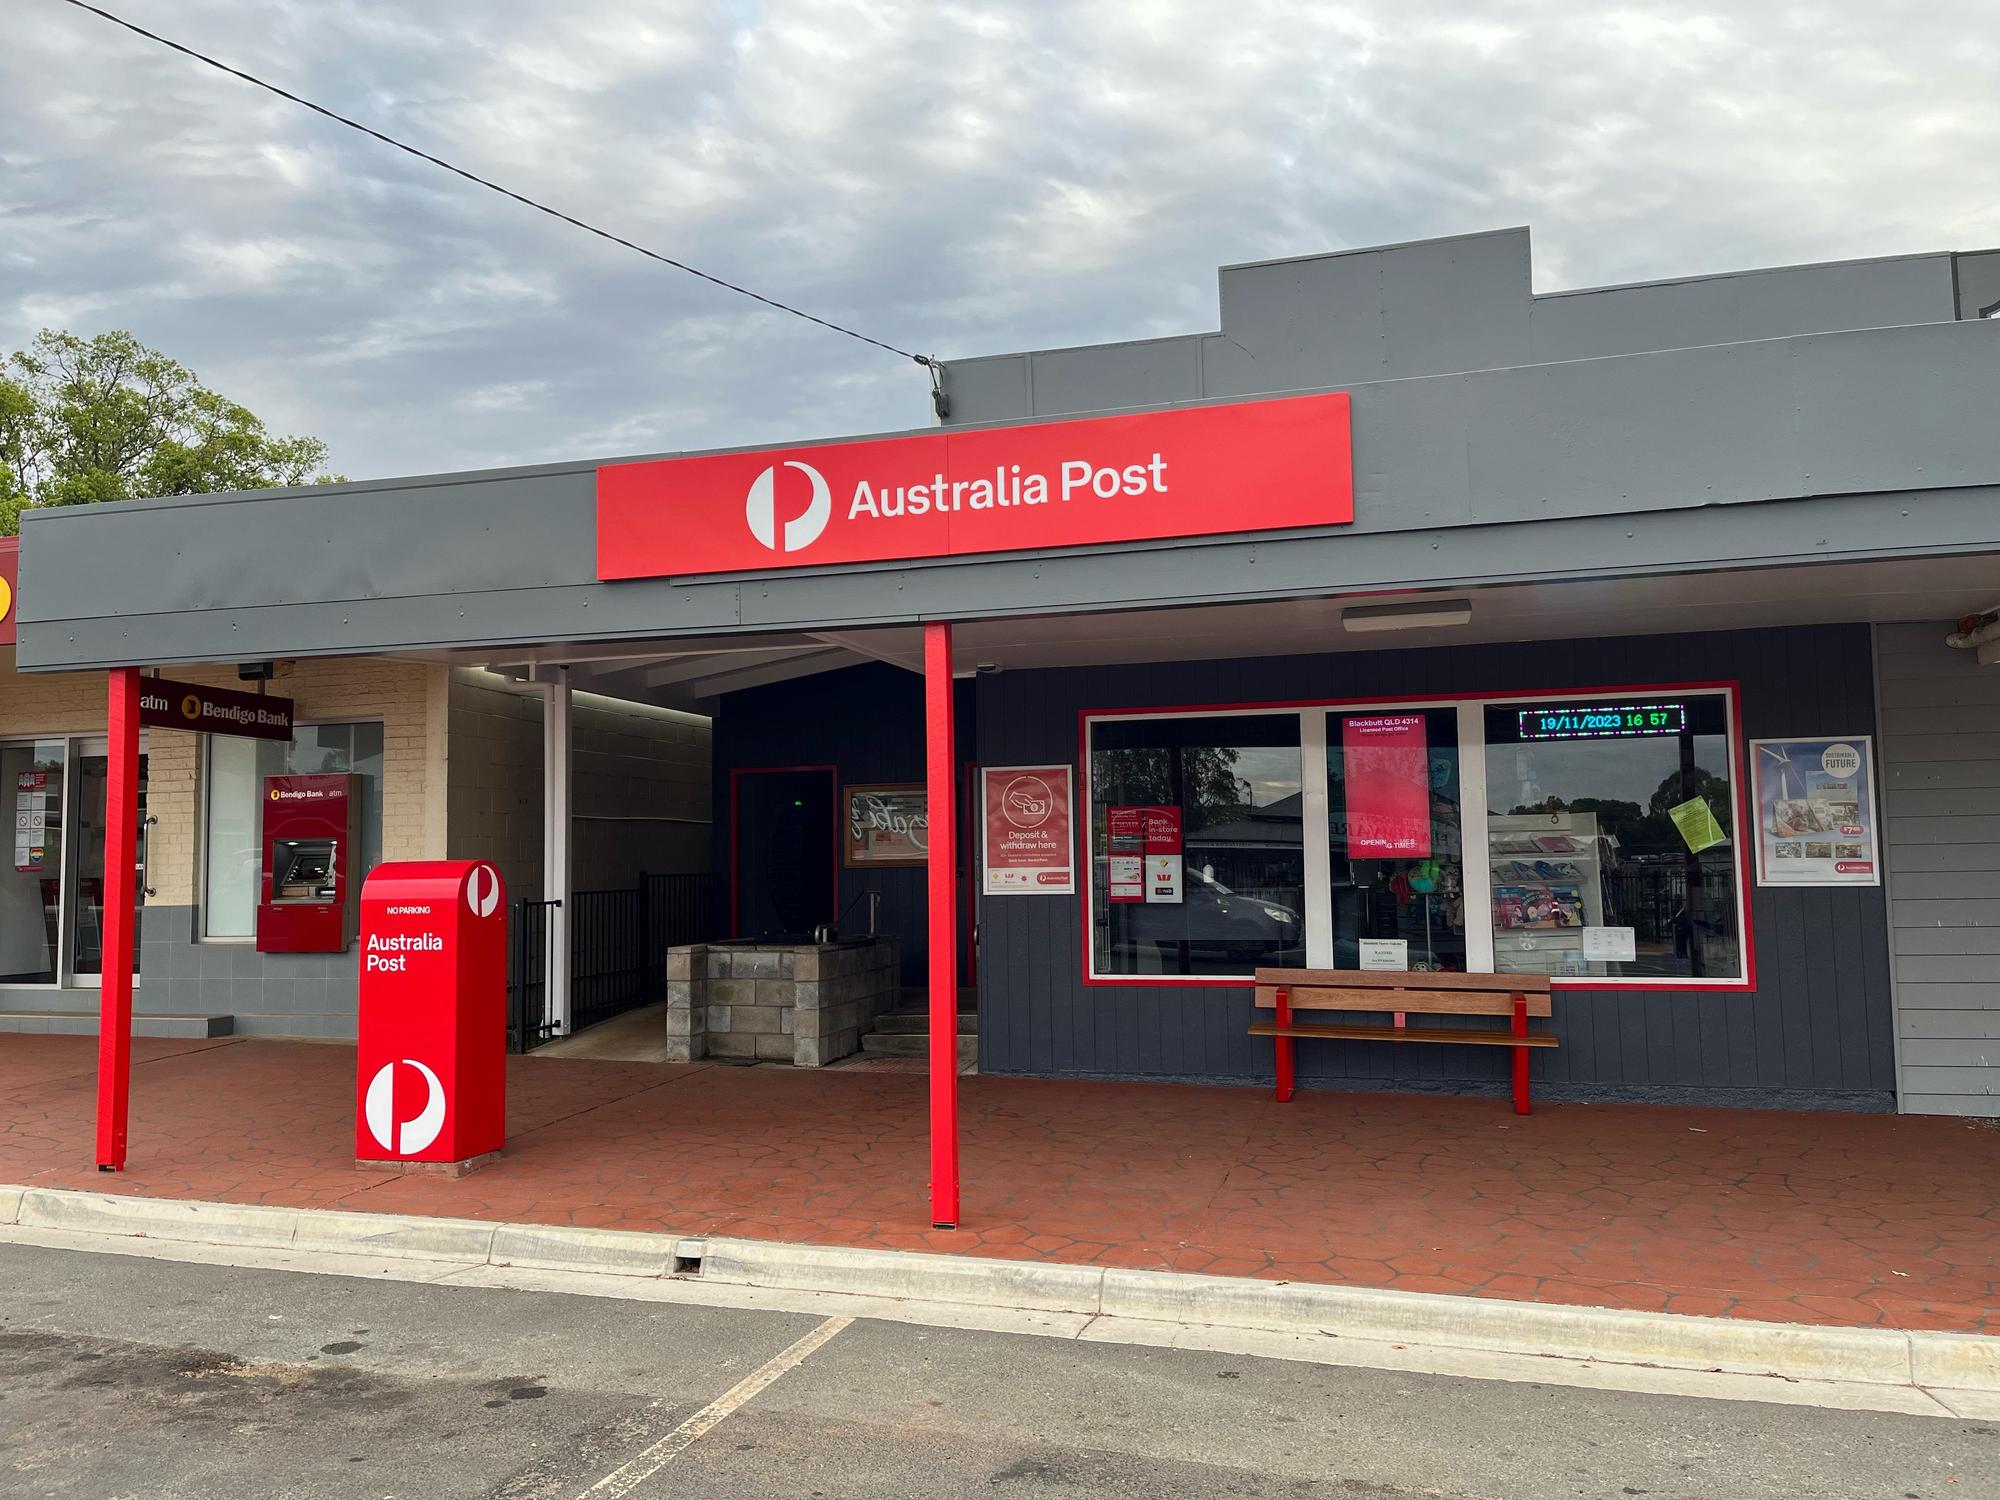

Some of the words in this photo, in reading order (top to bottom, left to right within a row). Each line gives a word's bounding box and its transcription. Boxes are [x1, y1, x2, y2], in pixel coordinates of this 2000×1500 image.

[848, 464, 1049, 520] Australia
[1061, 452, 1168, 500] Post
[140, 695, 168, 711] atm
[203, 702, 255, 724] Bendigo
[257, 709, 289, 727] Bank
[1540, 715, 1621, 730] 19/11/2023
[1627, 714, 1643, 727] 16
[1650, 713, 1667, 726] 57
[1826, 758, 1856, 768] FUTURE
[280, 791, 306, 799] Bendigo
[1009, 831, 1040, 840] Deposit
[1041, 830, 1048, 838] &
[1000, 841, 1038, 850] withdraw
[1038, 840, 1057, 849] here
[399, 906, 431, 914] PARKING
[367, 932, 443, 951] Australia
[367, 954, 406, 972] Post
